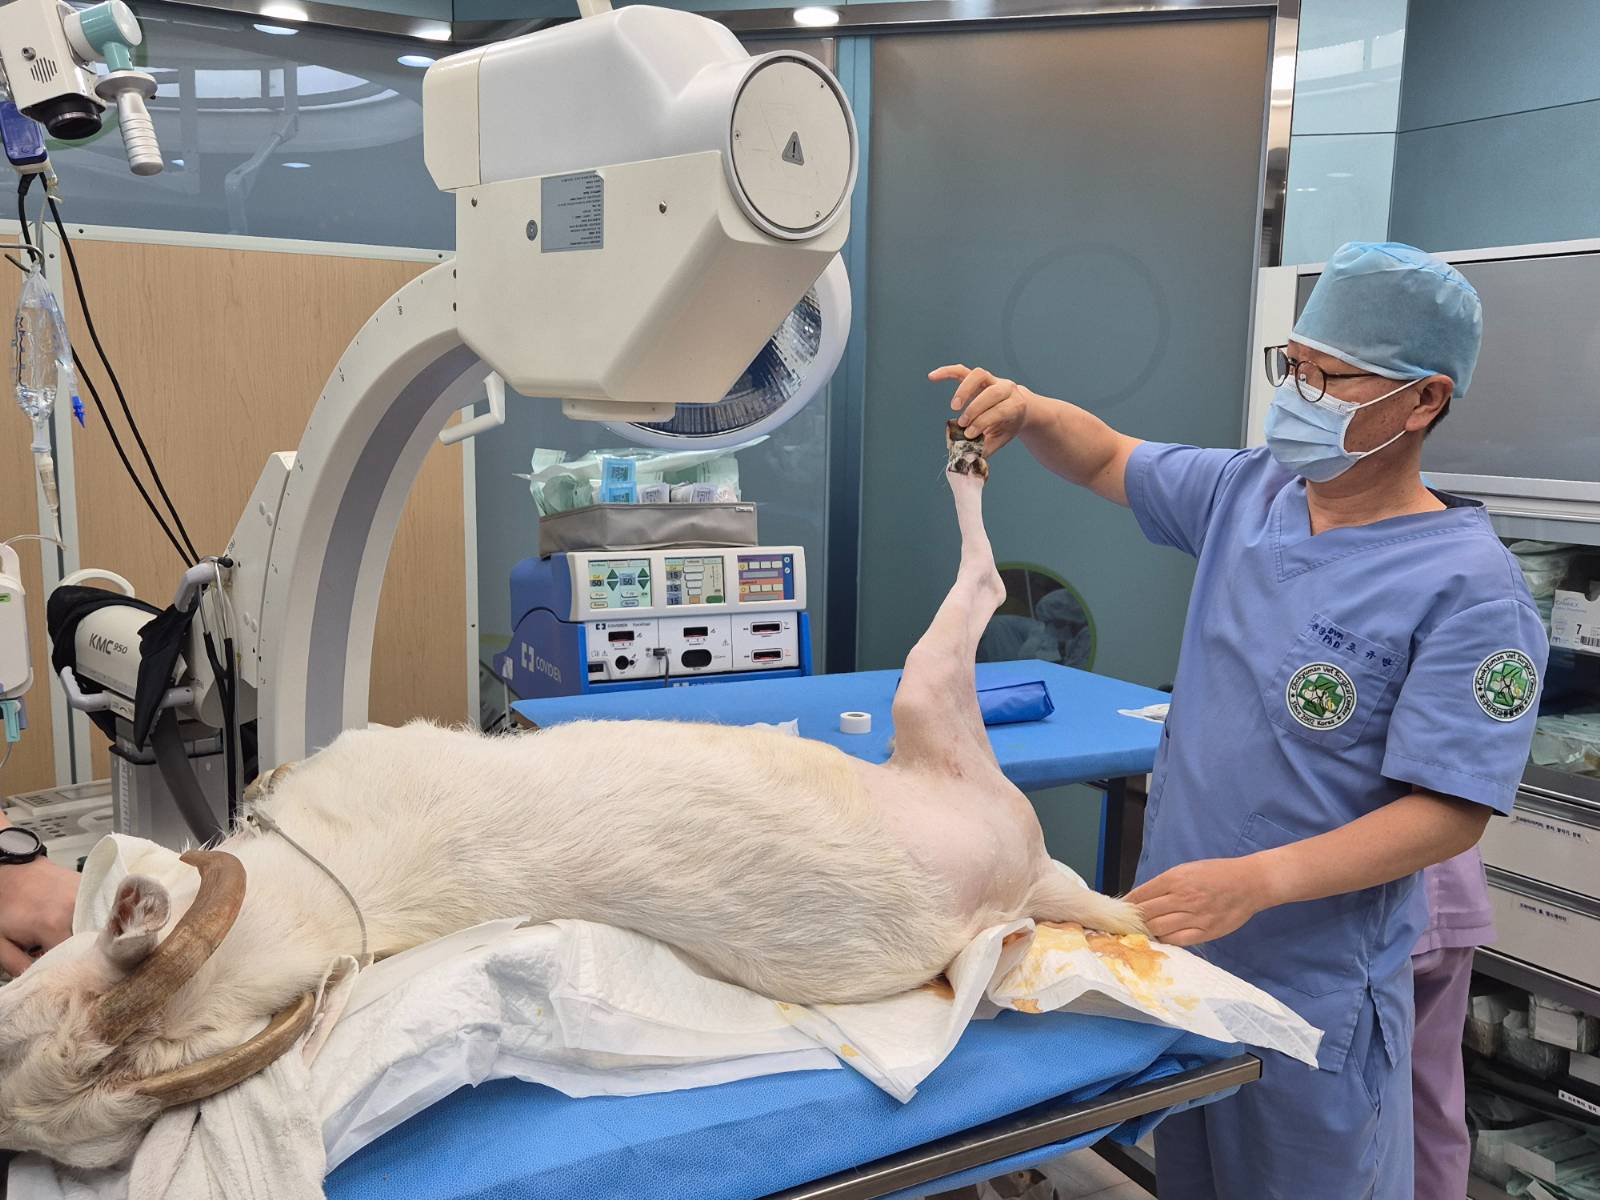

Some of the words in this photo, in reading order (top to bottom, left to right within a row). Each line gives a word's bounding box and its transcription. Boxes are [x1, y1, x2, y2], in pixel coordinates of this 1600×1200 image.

[1576, 623, 1582, 635] 7
[89, 633, 114, 655] KMC
[1323, 666, 1333, 674] Vet
